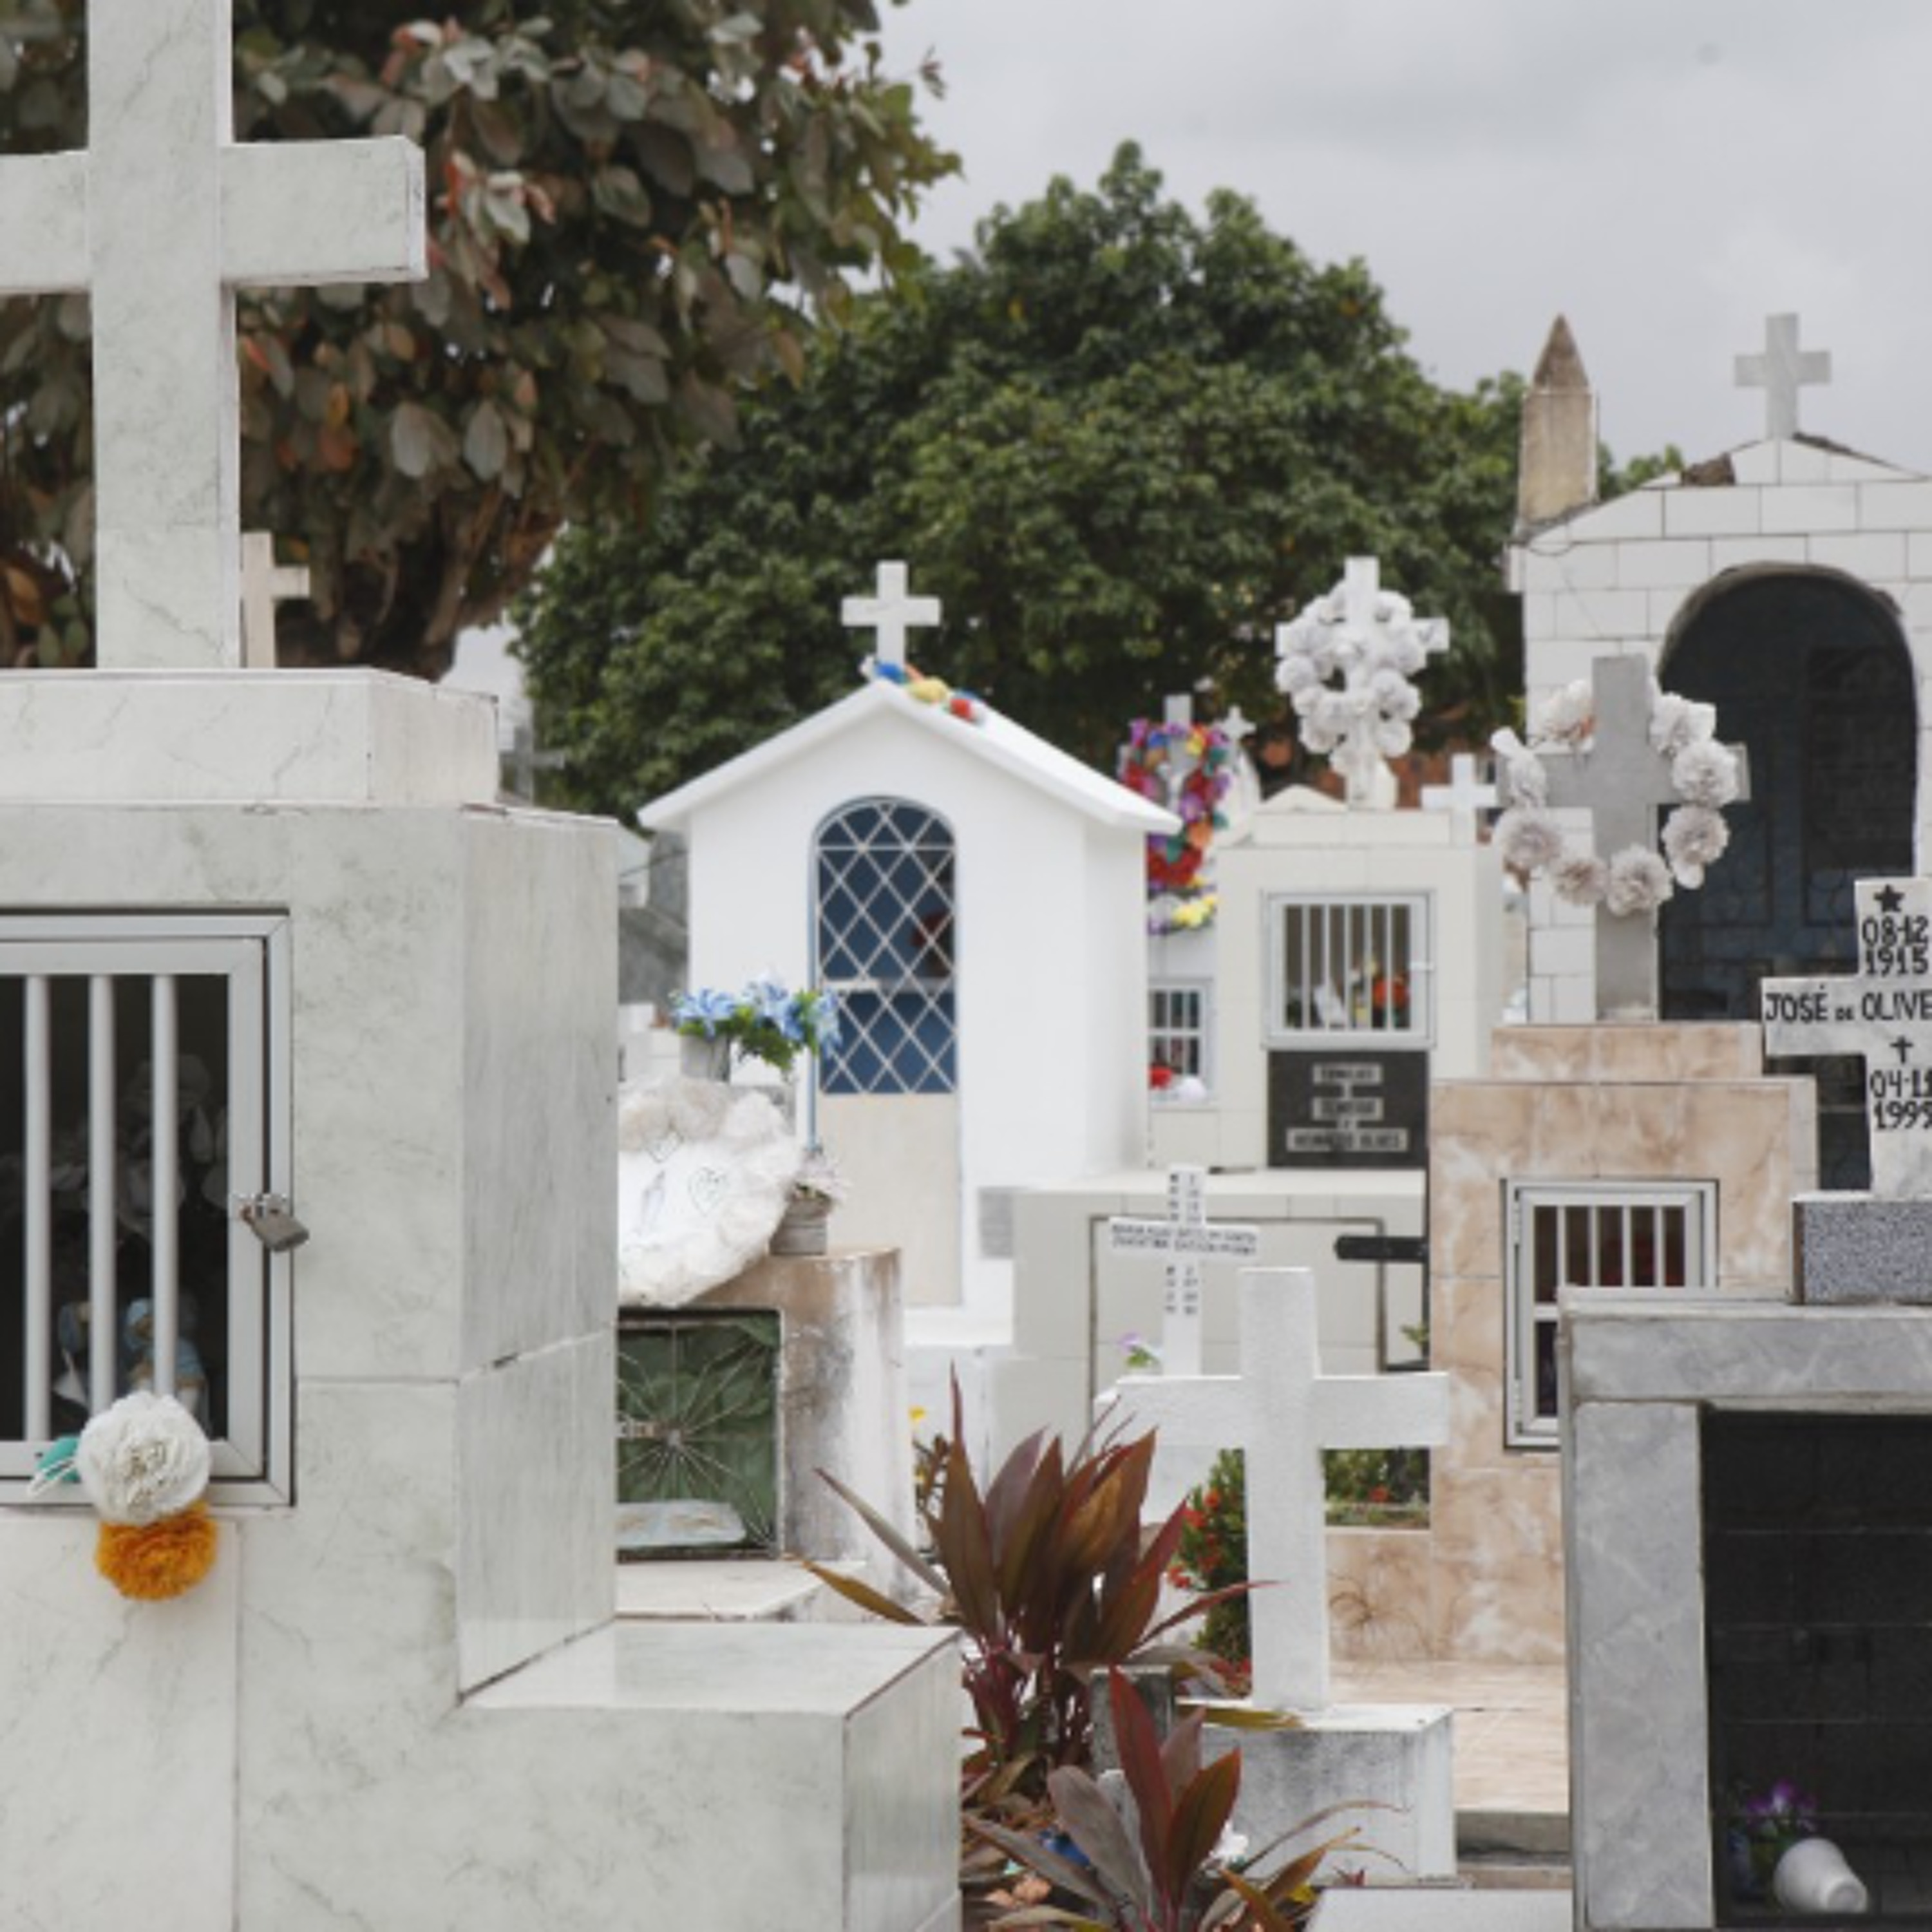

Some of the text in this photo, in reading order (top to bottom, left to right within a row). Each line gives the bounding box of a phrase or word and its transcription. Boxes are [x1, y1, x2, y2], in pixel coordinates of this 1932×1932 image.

[1866, 946, 1929, 977] 1915
[1765, 983, 1828, 1023] JOSÉ
[1862, 990, 1932, 1021] OLIVE
